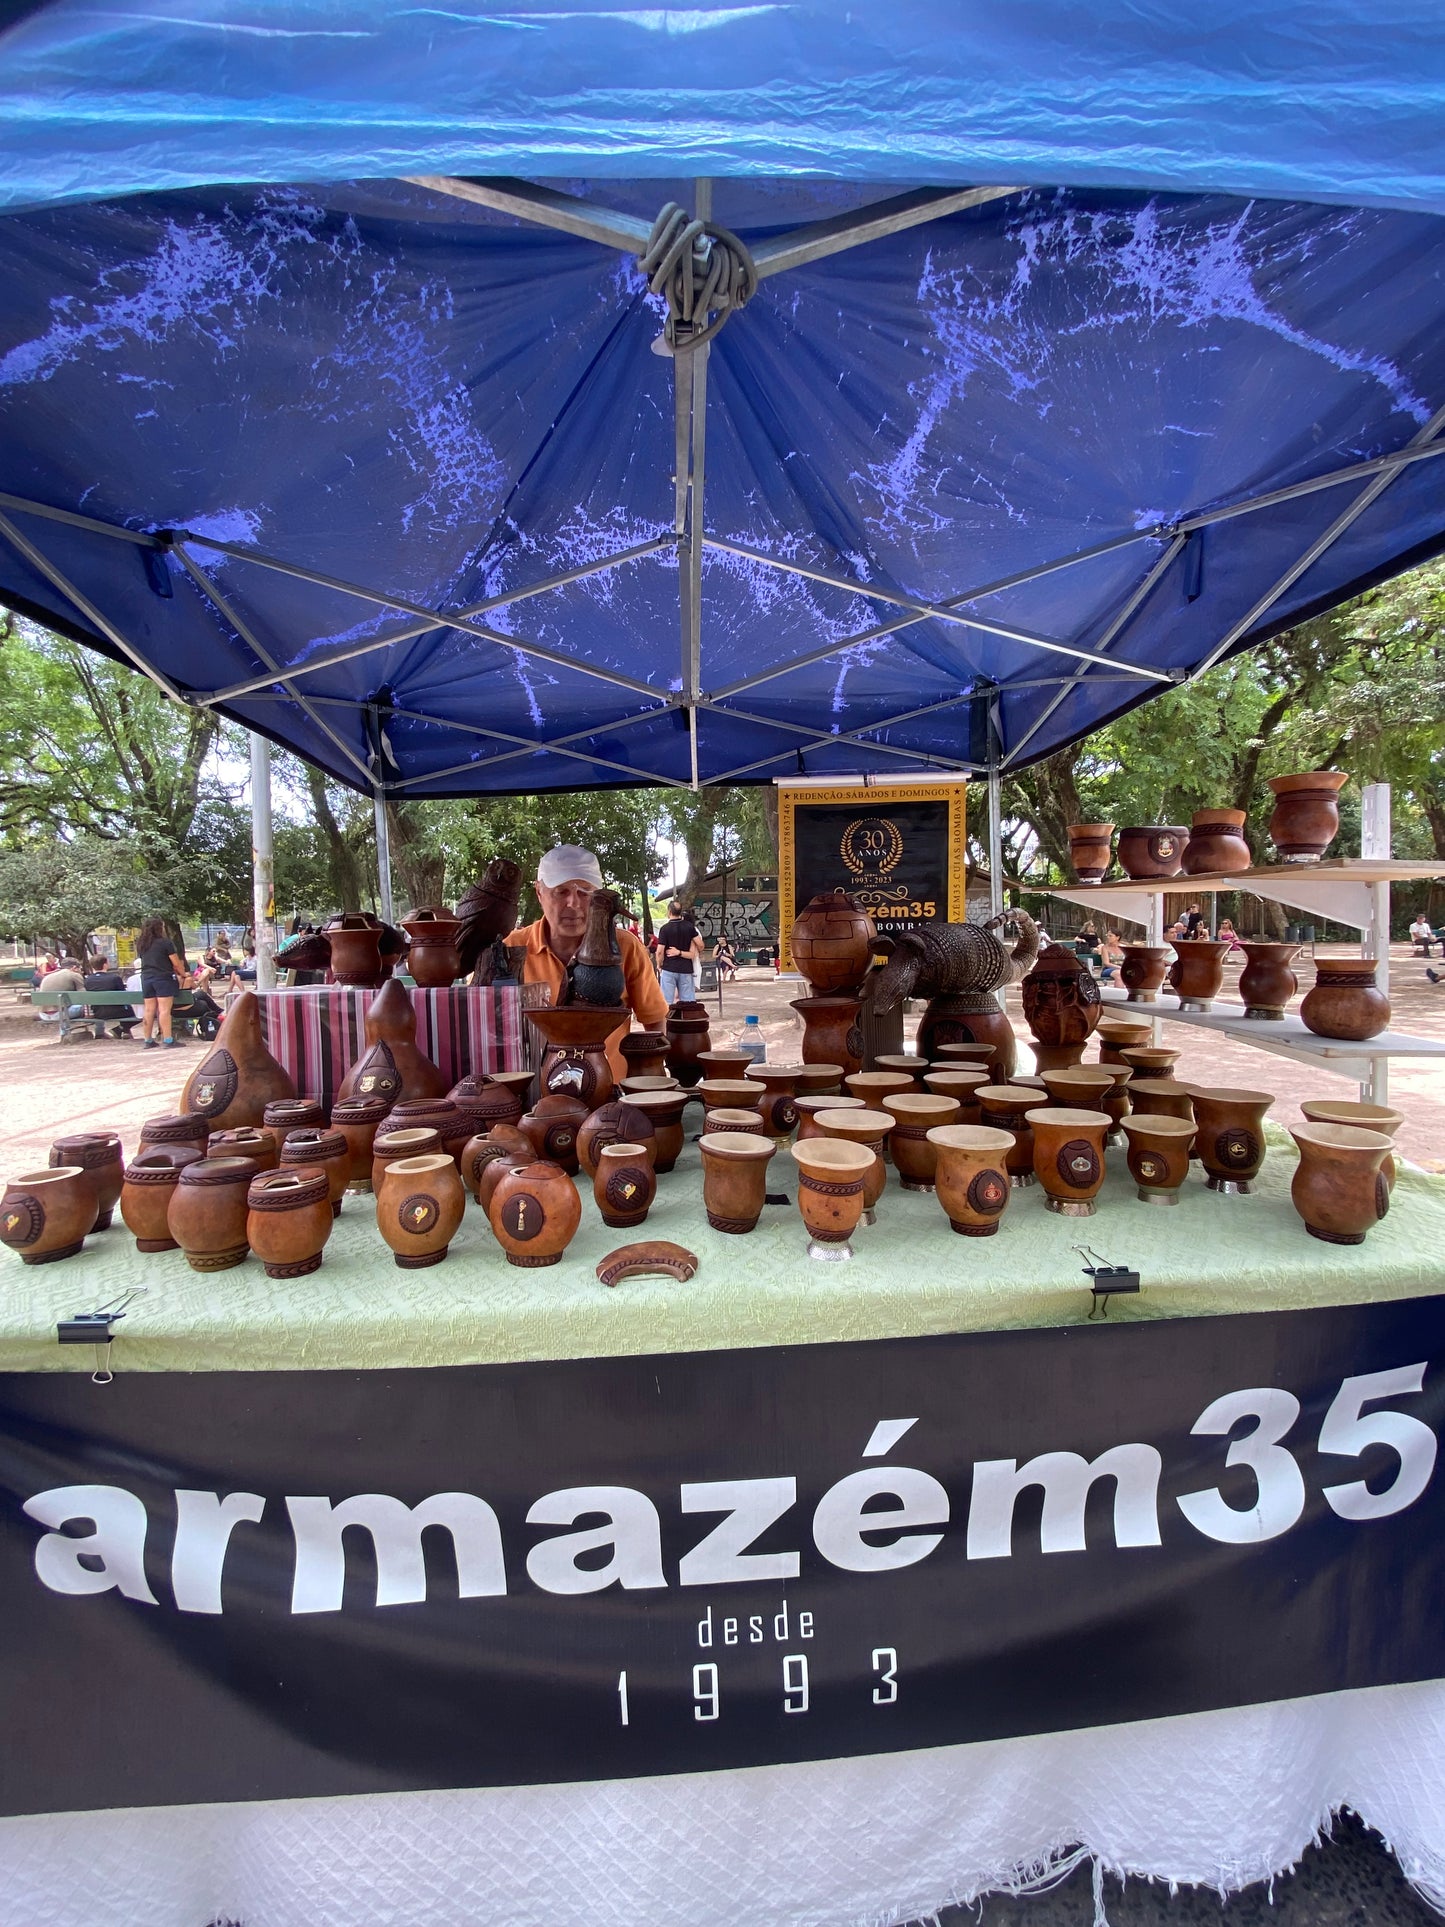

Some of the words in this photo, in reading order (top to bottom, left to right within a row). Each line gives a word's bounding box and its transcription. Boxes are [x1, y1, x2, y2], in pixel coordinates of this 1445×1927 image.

[899, 788, 950, 797] DOMINGOS
[860, 830, 884, 849] 30
[858, 849, 887, 857] ANOS
[953, 799, 961, 923] AZÉM35.CUIAS.BOMBAS
[851, 877, 868, 885] 1993
[874, 876, 892, 884] 2023
[866, 902, 936, 918] zém35
[877, 922, 931, 931] BOMB
[23, 1362, 1438, 1615] armazém35
[698, 1600, 814, 1648] desde
[618, 1648, 898, 1726] 1993
